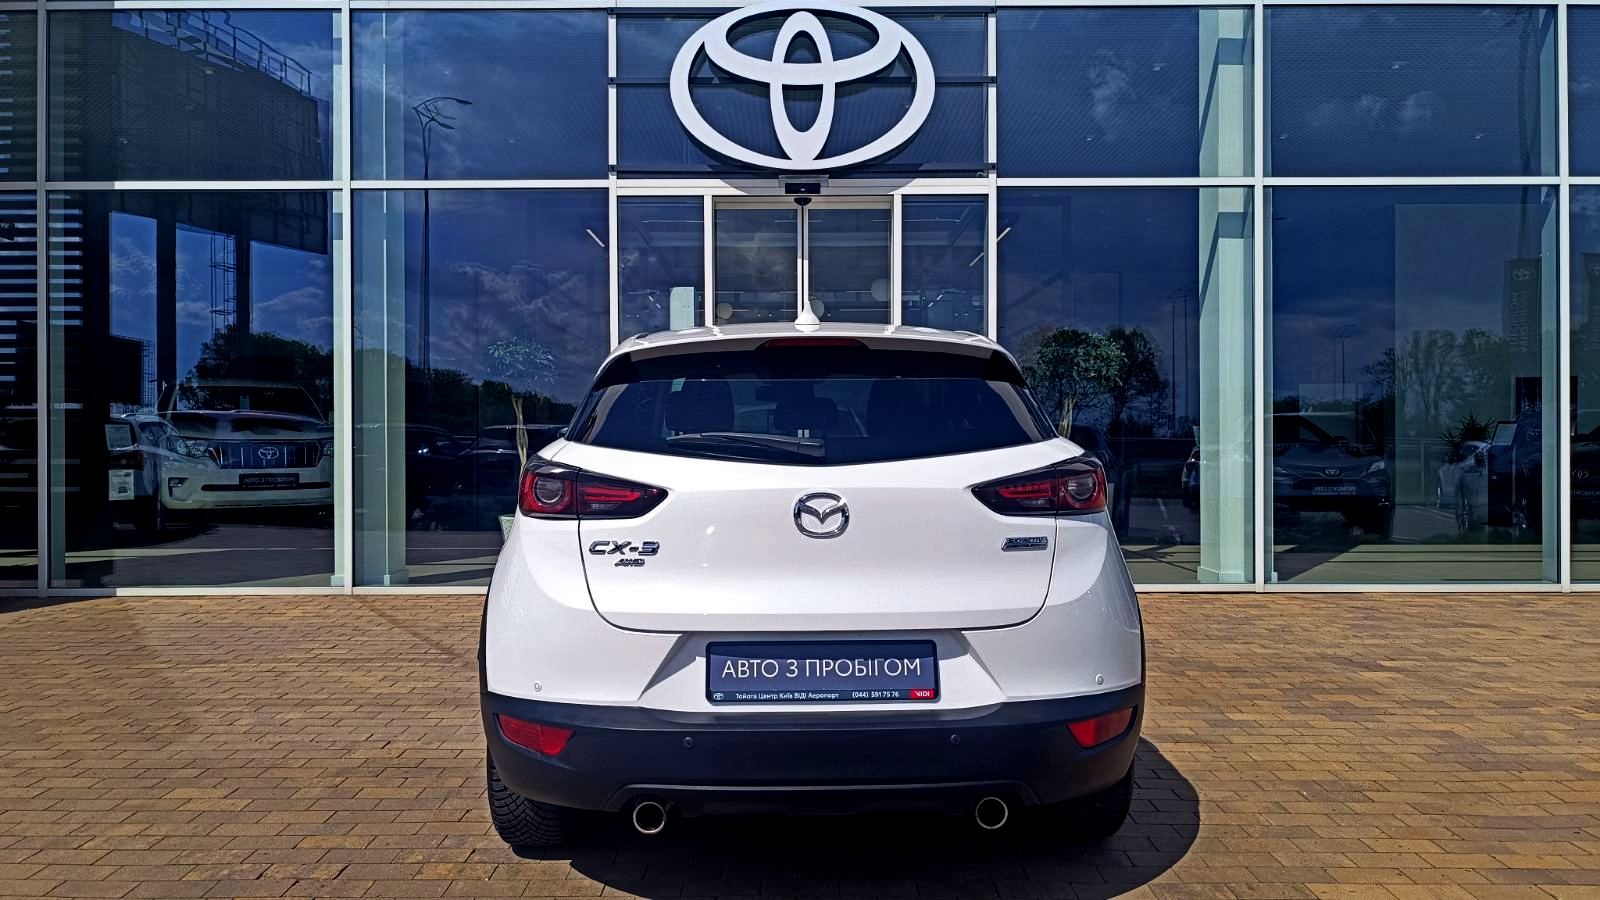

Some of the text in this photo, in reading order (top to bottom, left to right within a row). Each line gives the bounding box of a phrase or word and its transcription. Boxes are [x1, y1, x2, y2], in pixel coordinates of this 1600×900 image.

[588, 540, 661, 557] CX-3
[614, 558, 646, 567] AWD
[721, 657, 921, 678] АВТО З ПРОБІГОМ
[735, 692, 758, 700] Тойота
[758, 692, 779, 701] Центр
[779, 691, 793, 699] Київ
[808, 692, 840, 701] Аеропорт
[852, 691, 869, 699] (044)
